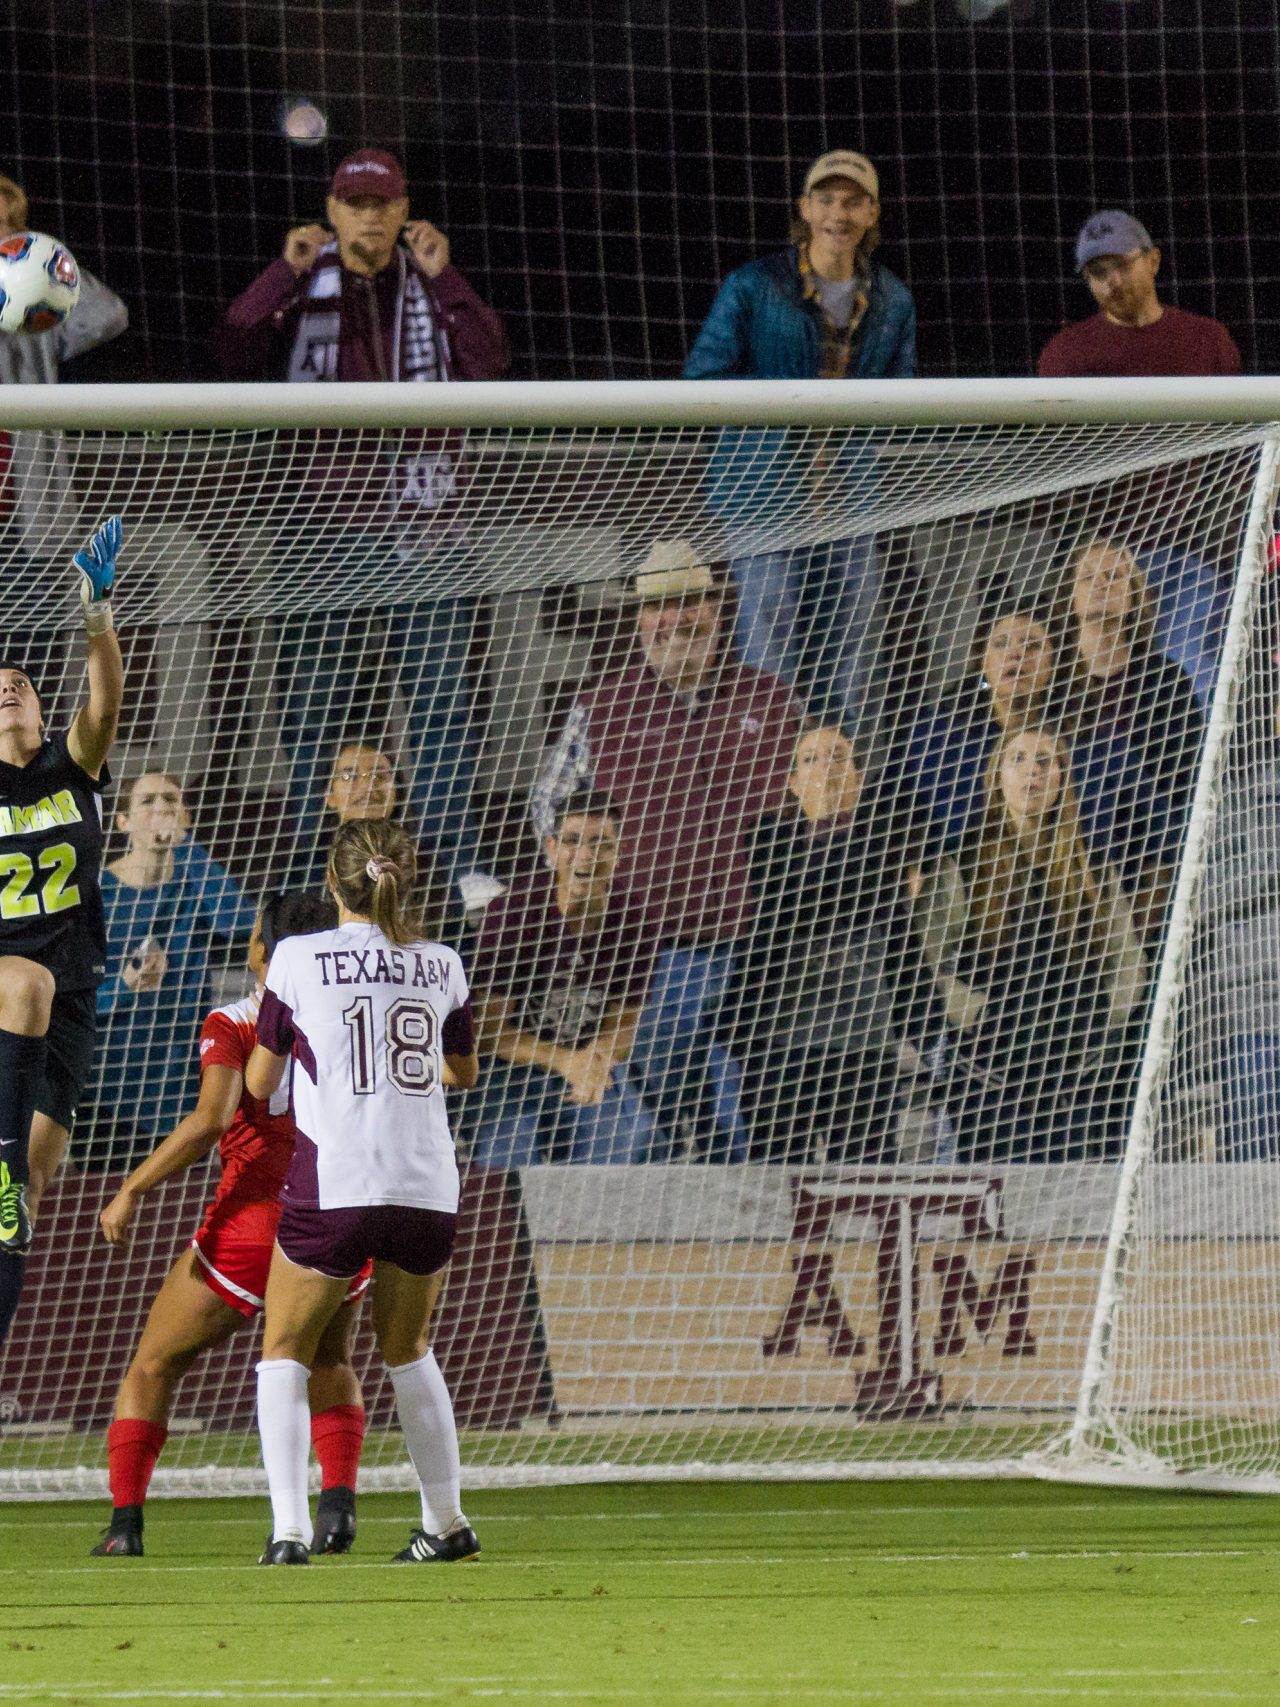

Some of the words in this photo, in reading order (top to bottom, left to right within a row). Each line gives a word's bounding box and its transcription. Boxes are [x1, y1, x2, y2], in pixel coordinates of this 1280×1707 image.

[315, 949, 406, 986] TEXAS
[412, 952, 451, 995] A&M
[342, 995, 439, 1098] 18
